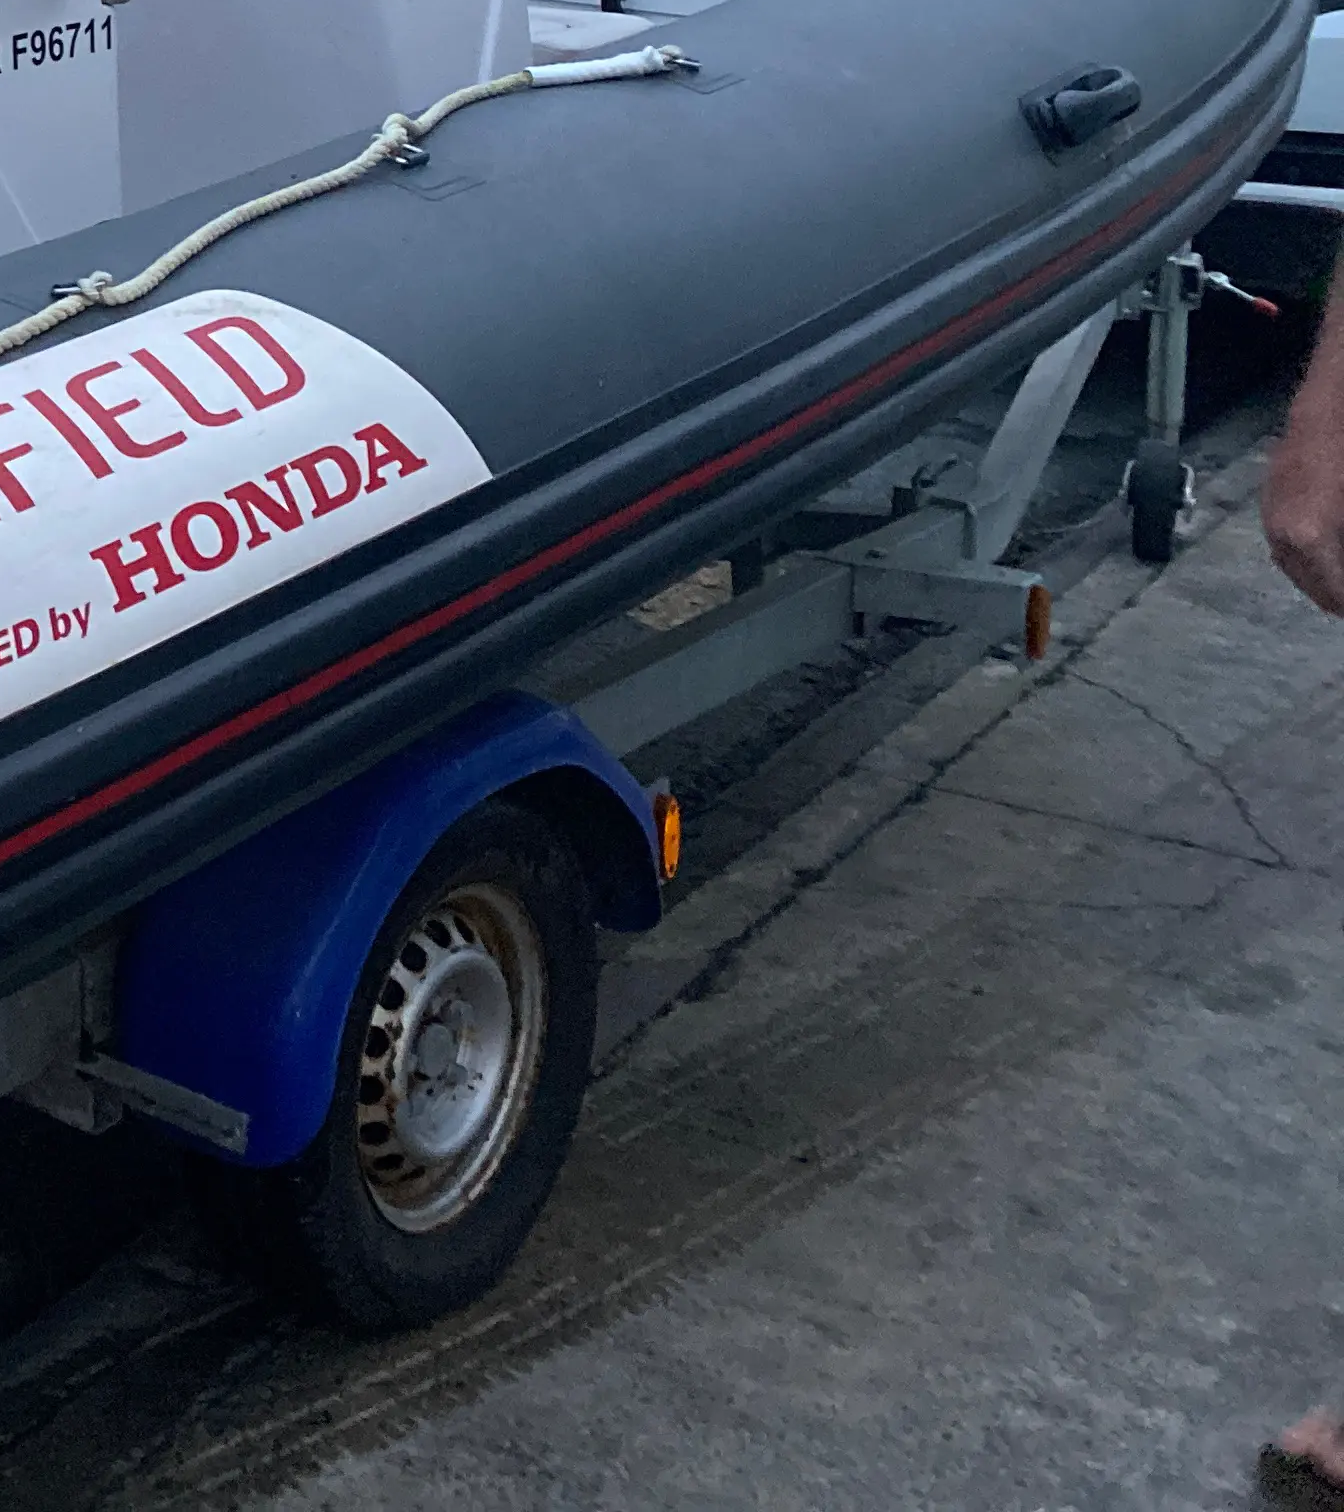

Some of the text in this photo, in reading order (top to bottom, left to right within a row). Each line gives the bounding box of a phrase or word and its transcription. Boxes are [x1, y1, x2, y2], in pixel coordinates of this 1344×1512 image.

[12, 14, 112, 71] F96711
[50, 600, 93, 641] by
[89, 421, 429, 614] HONDA
